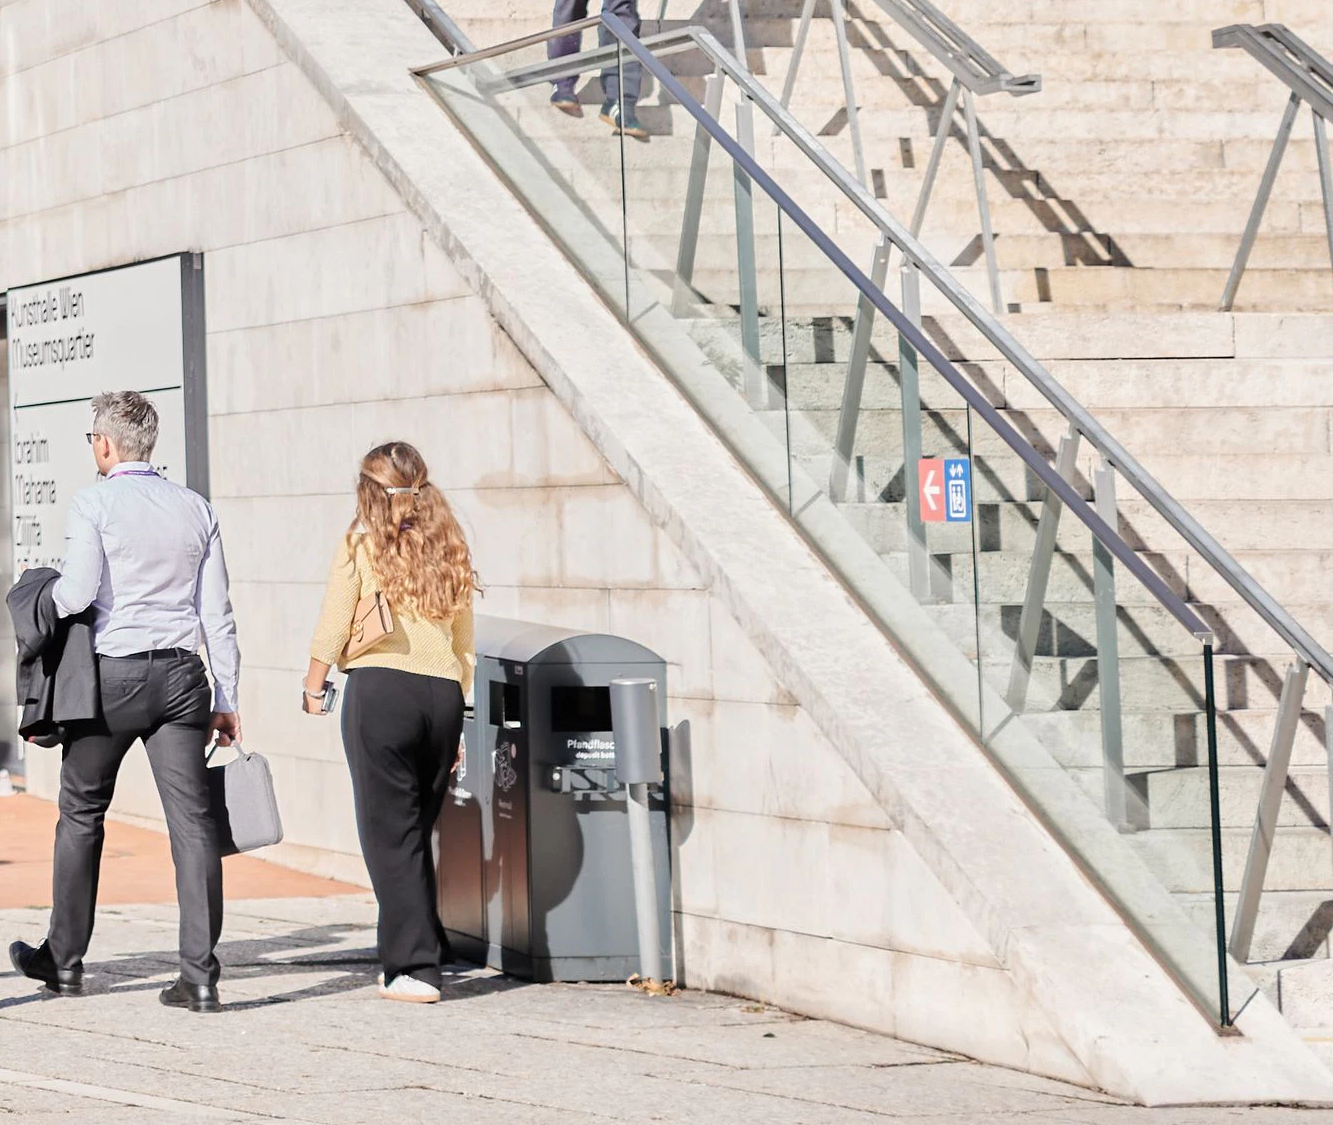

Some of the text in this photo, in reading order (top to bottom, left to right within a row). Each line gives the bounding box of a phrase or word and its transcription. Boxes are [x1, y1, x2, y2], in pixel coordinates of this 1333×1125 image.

[11, 286, 85, 330] Kunsthalle Wien
[12, 328, 95, 371] Museumsquartier
